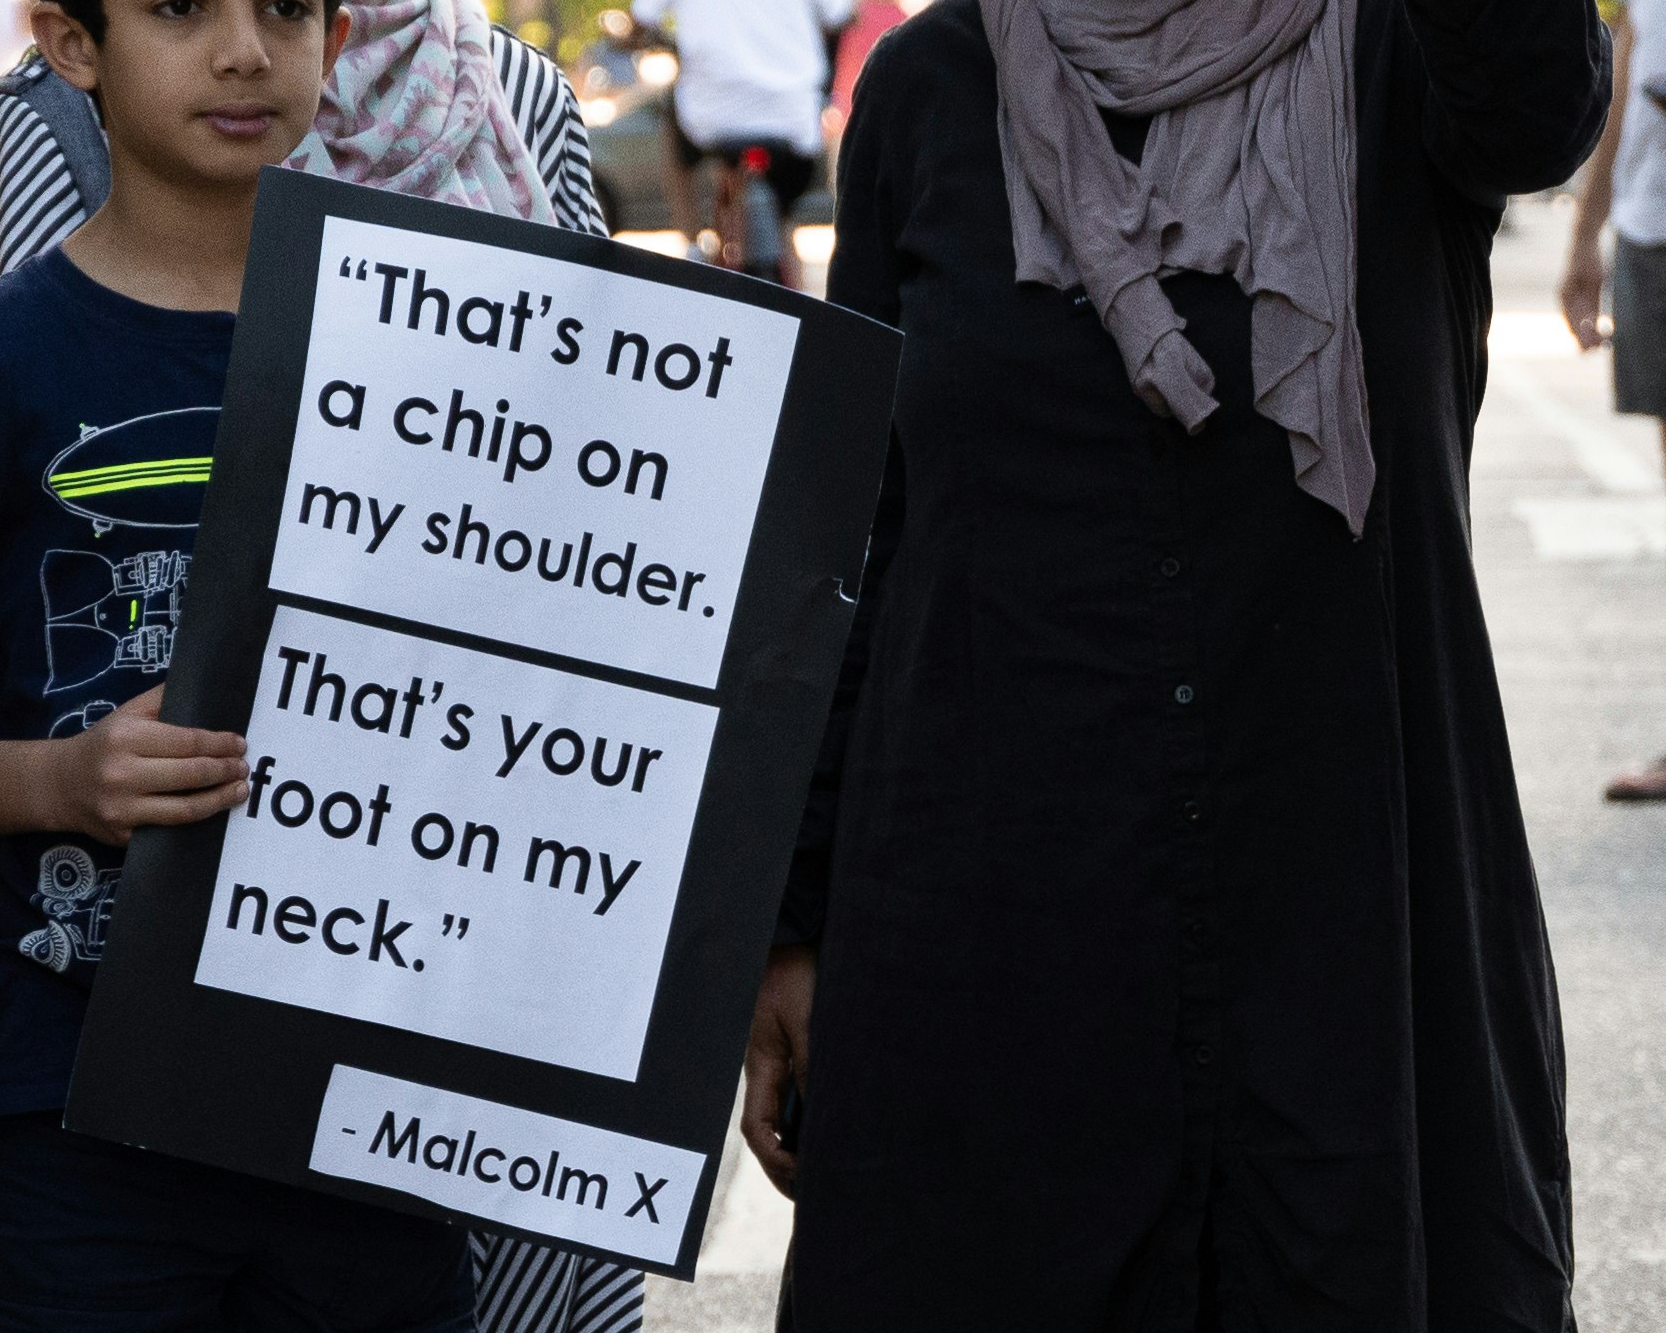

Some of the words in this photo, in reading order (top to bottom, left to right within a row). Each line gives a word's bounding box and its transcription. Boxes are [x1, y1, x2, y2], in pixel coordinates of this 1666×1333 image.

[341, 258, 583, 364] “That’s
[607, 331, 732, 398] not
[319, 381, 365, 430] a
[394, 390, 552, 482] chip
[578, 440, 667, 500] on
[300, 484, 404, 553] my
[422, 504, 714, 617] shoulder.
[278, 647, 473, 750] That’s
[497, 715, 662, 792] your
[246, 757, 391, 846] foot
[412, 813, 499, 872] on
[525, 838, 641, 915] my
[227, 884, 469, 971] neck.”
[369, 1111, 607, 1209] Malcolm
[626, 1173, 667, 1223] X
